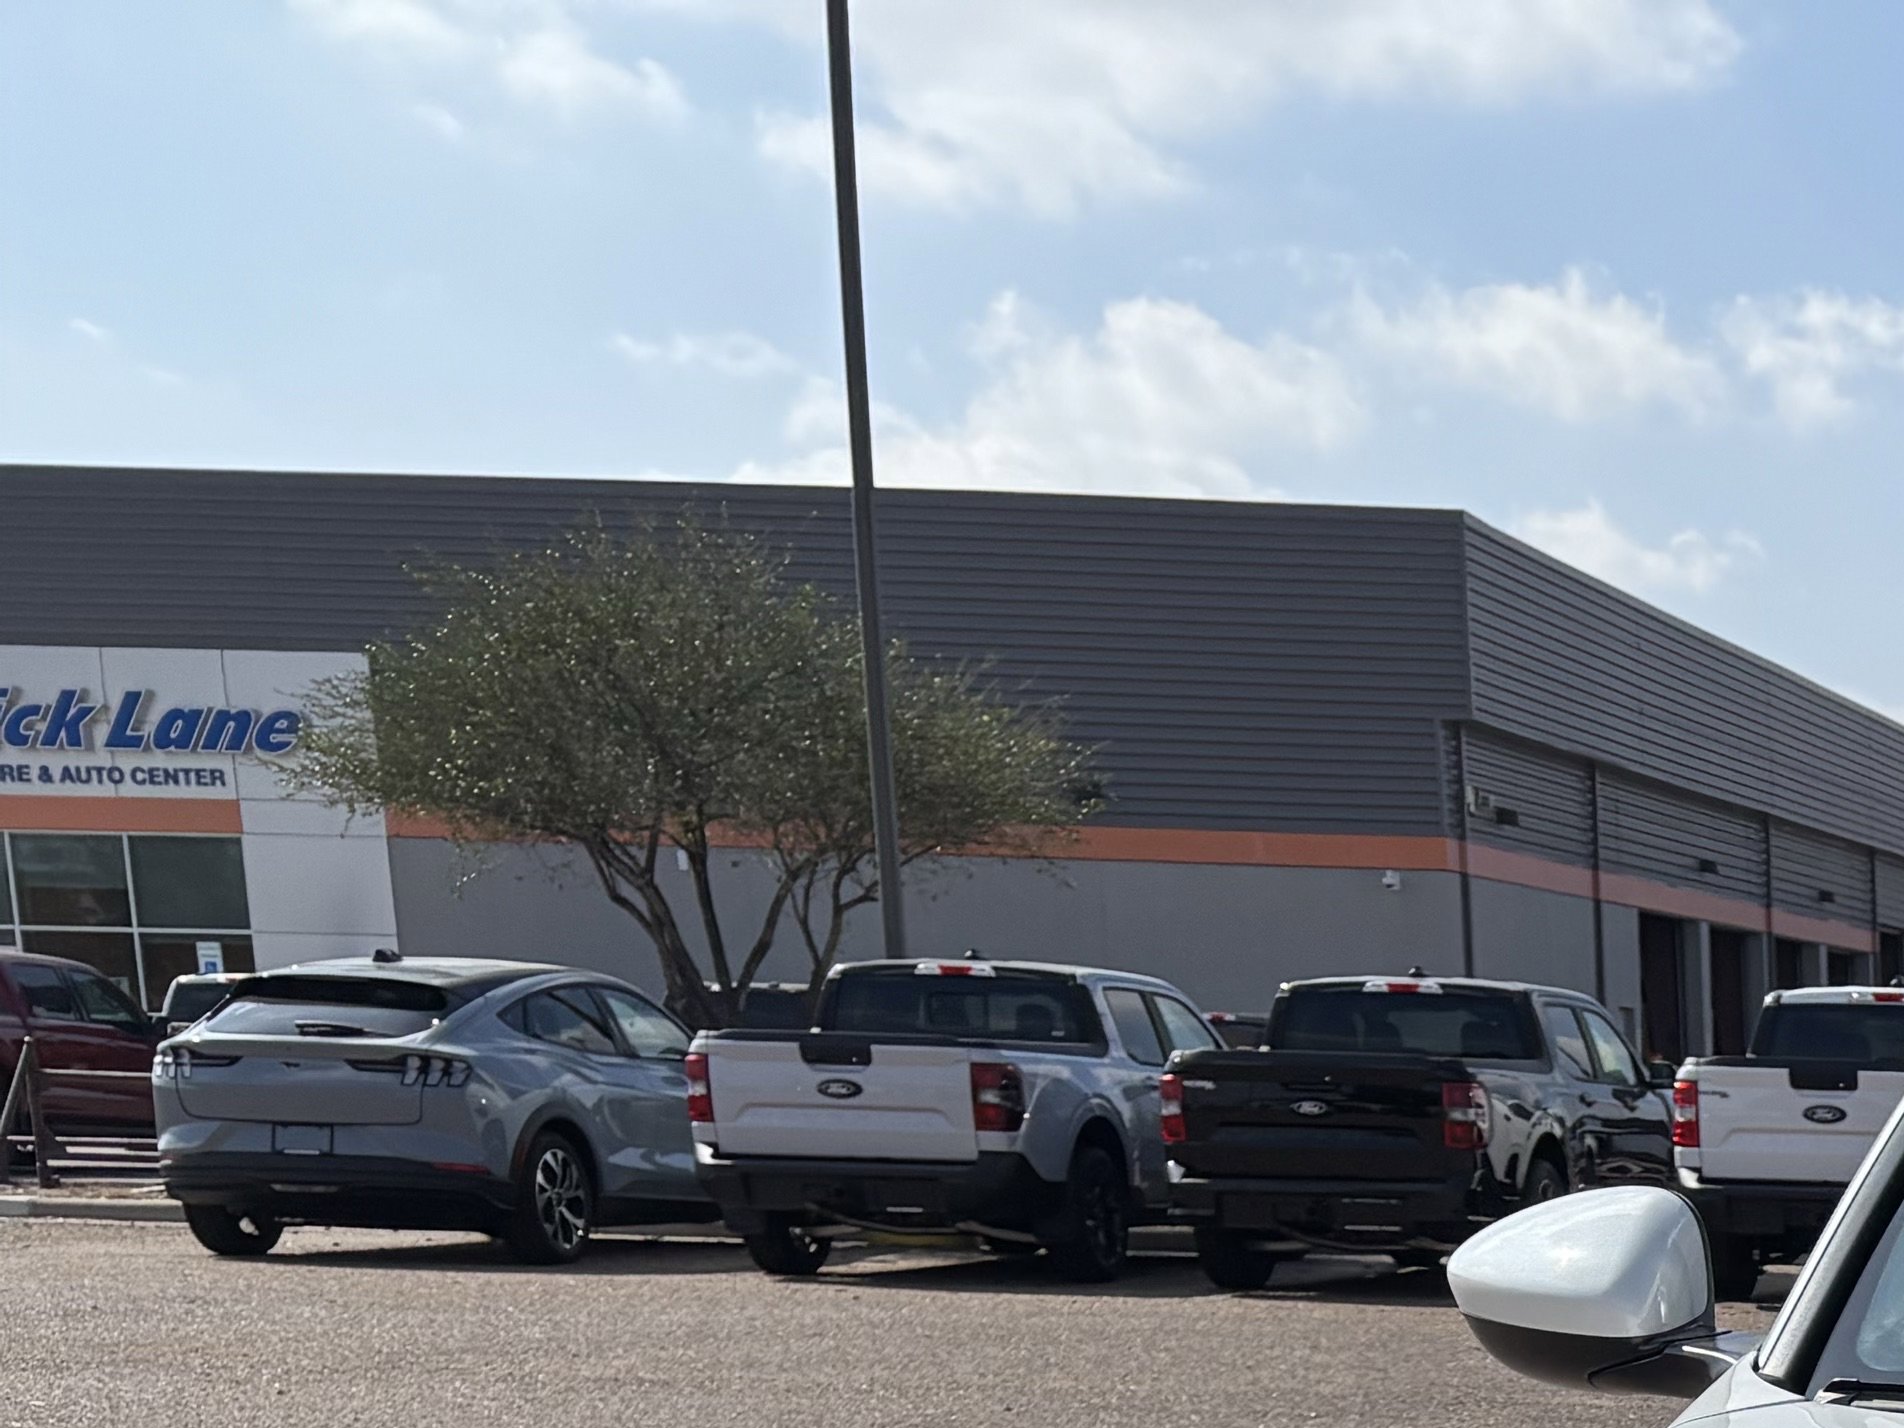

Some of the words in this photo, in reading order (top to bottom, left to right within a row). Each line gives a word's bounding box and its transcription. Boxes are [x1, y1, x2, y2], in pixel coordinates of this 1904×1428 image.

[0, 687, 98, 749] ck
[103, 690, 300, 752] Lane
[38, 764, 54, 784] &
[59, 765, 125, 785] AUTO
[130, 767, 226, 788] CENTER
